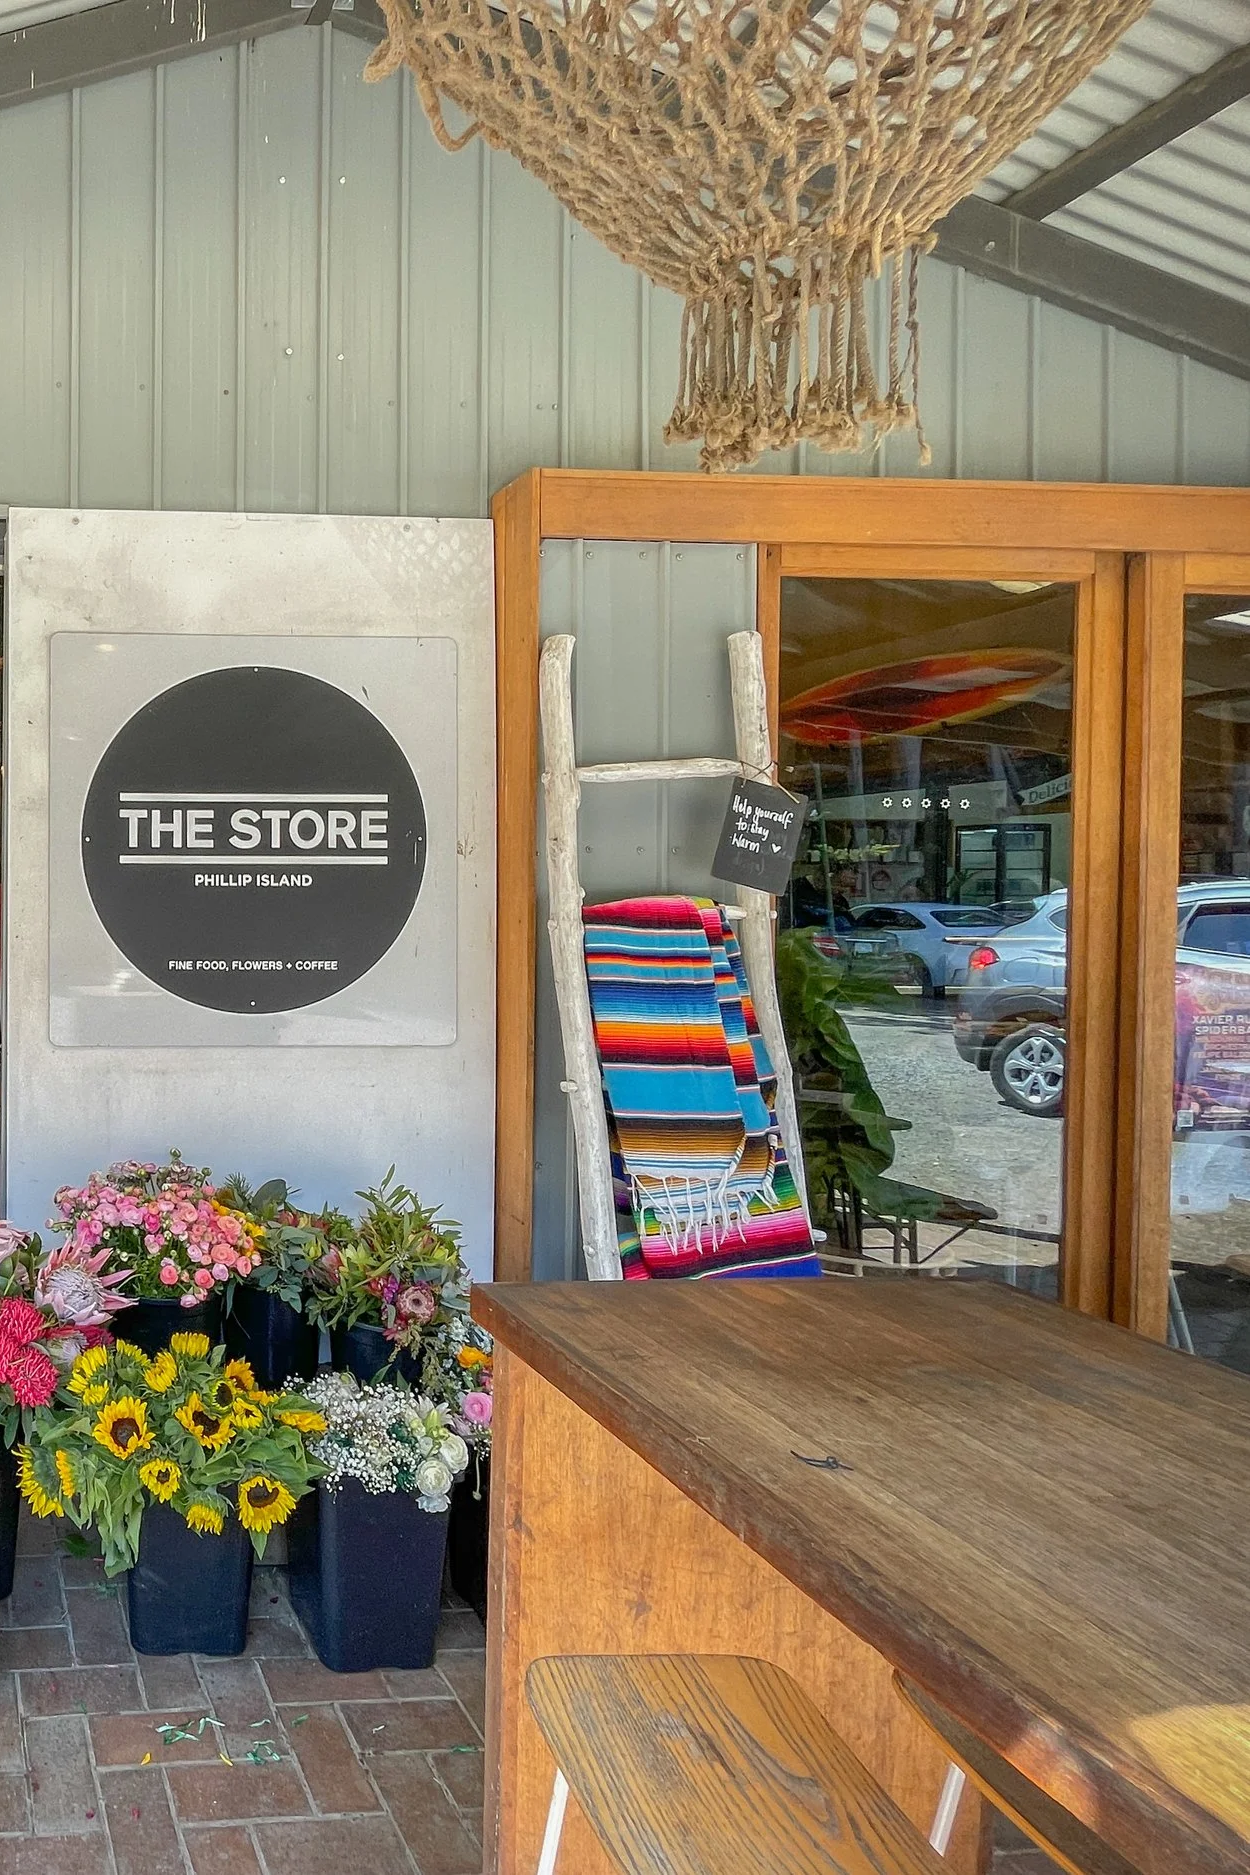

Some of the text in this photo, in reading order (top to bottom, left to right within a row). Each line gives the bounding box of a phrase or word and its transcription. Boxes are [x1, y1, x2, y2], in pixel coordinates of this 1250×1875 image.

[733, 795, 794, 830] Help yourself
[119, 808, 389, 849] THE STORE
[735, 817, 770, 842] to stay
[731, 832, 760, 853] Warm
[194, 874, 313, 887] PHILLIP ISLAND
[168, 961, 193, 970] FINE
[196, 961, 229, 972] FOOD,
[231, 961, 283, 970] FLOWERS
[295, 961, 338, 970] COFFEE
[1192, 1015, 1234, 1024] XAVIER
